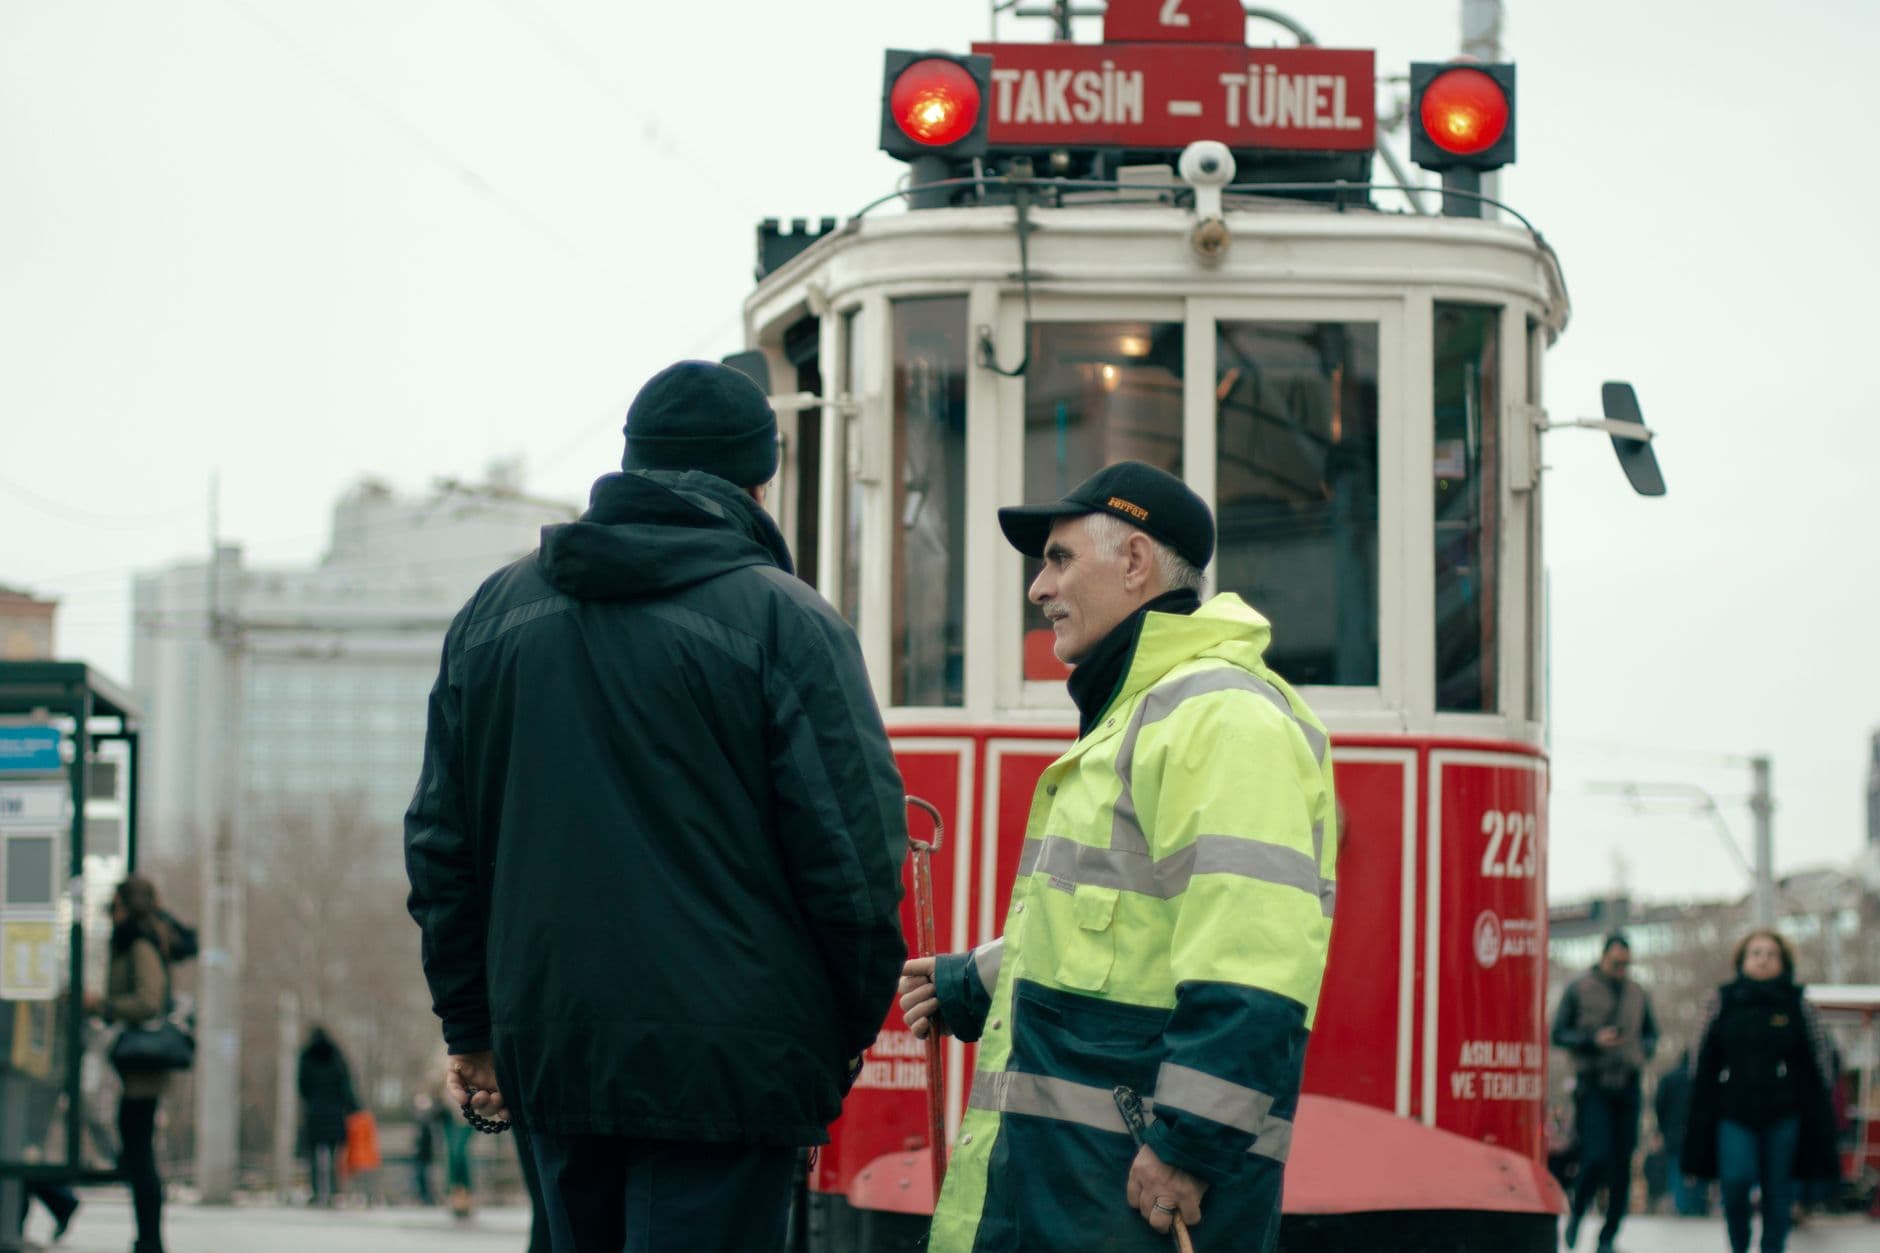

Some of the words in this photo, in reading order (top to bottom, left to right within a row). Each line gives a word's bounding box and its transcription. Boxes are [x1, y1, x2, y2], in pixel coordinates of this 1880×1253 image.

[991, 60, 1144, 124] TAKSİM
[1219, 64, 1362, 130] TÜNEL
[1450, 1071, 1477, 1100] VE
